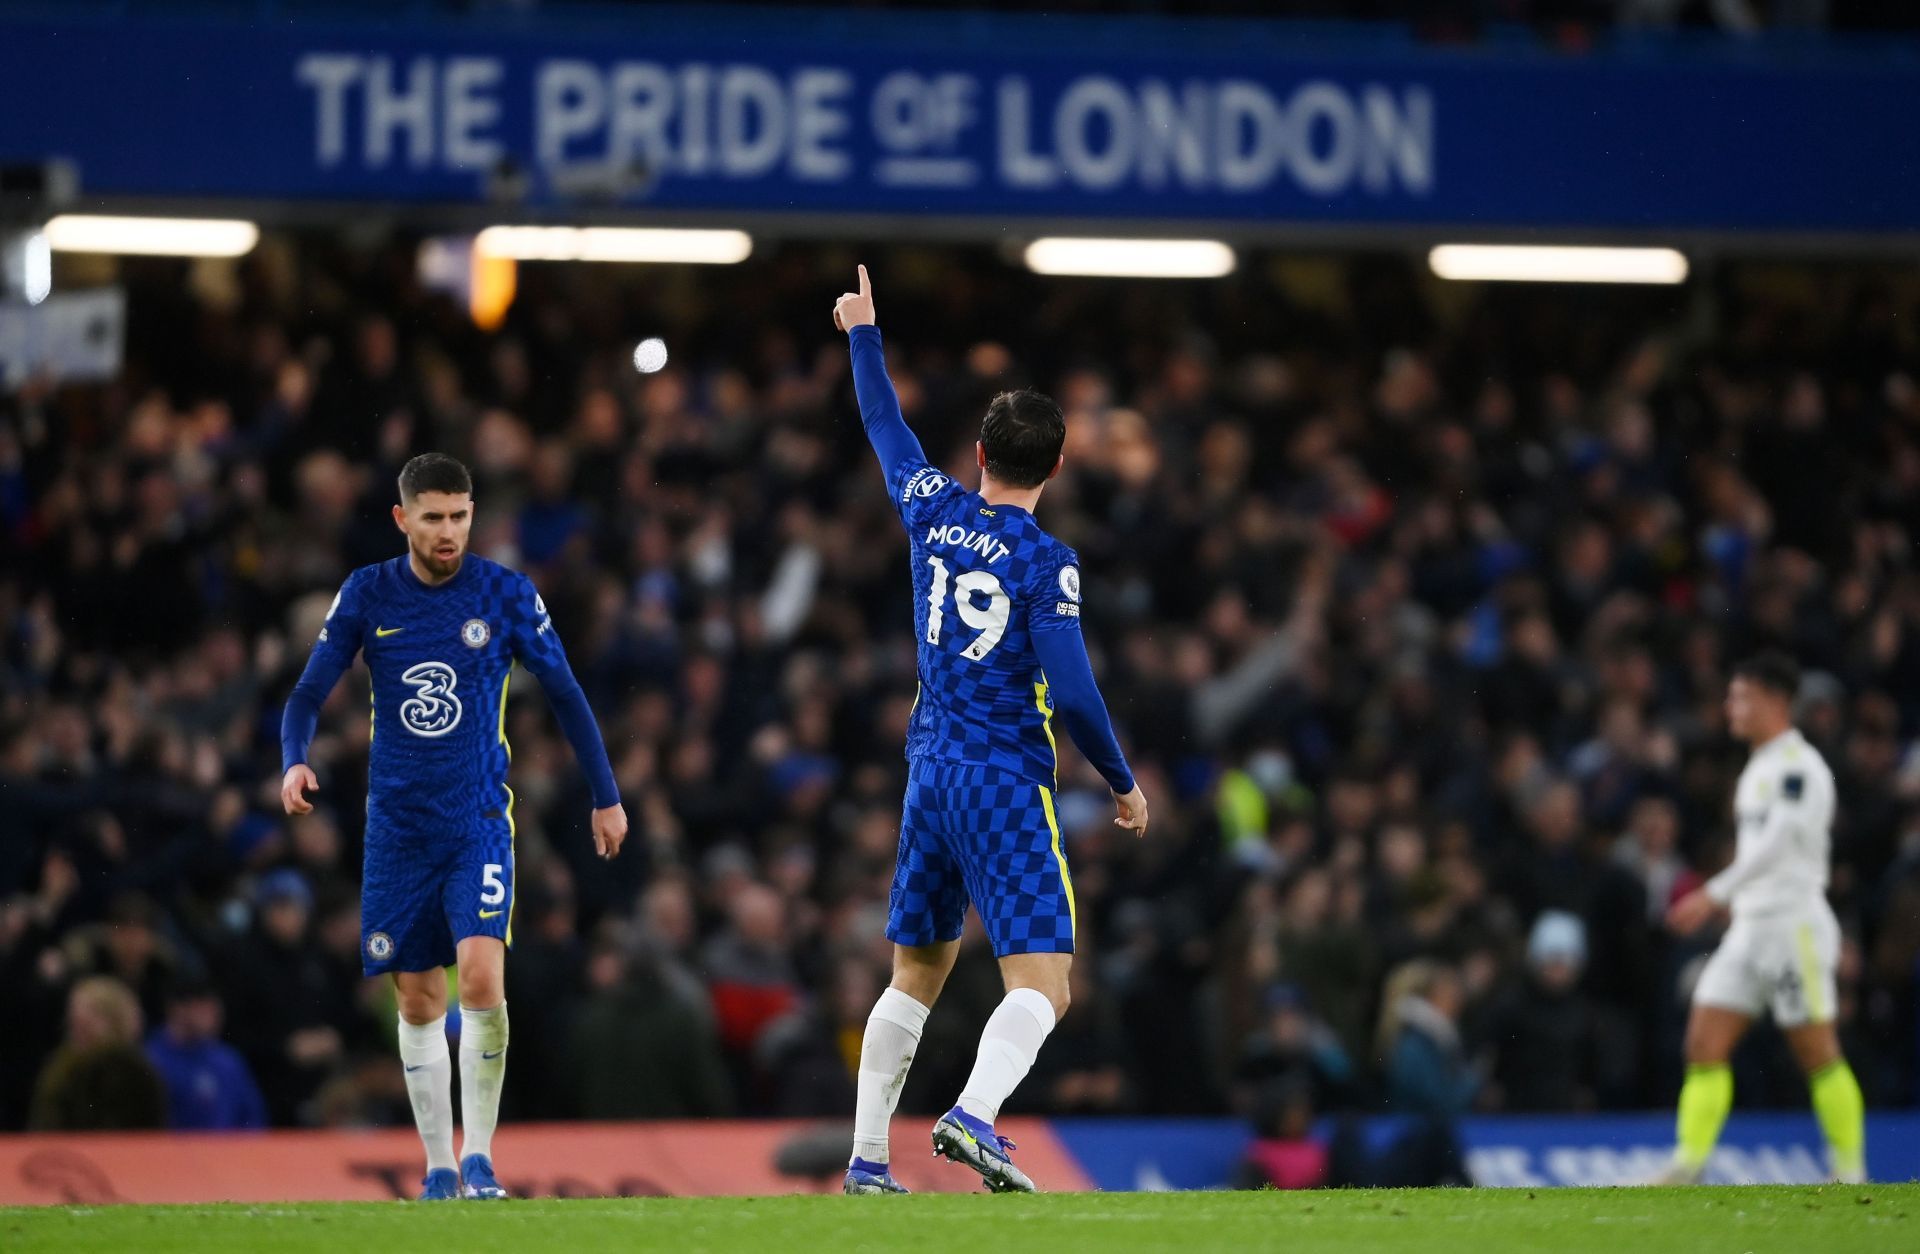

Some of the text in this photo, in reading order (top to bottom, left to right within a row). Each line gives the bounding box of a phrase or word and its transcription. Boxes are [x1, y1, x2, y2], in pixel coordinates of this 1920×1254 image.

[301, 56, 1431, 190] THE PRIDE OF LONDON
[979, 508, 996, 517] CFC
[926, 525, 1009, 564] MOUNT
[926, 555, 1011, 661] 19
[481, 864, 505, 904] 5
